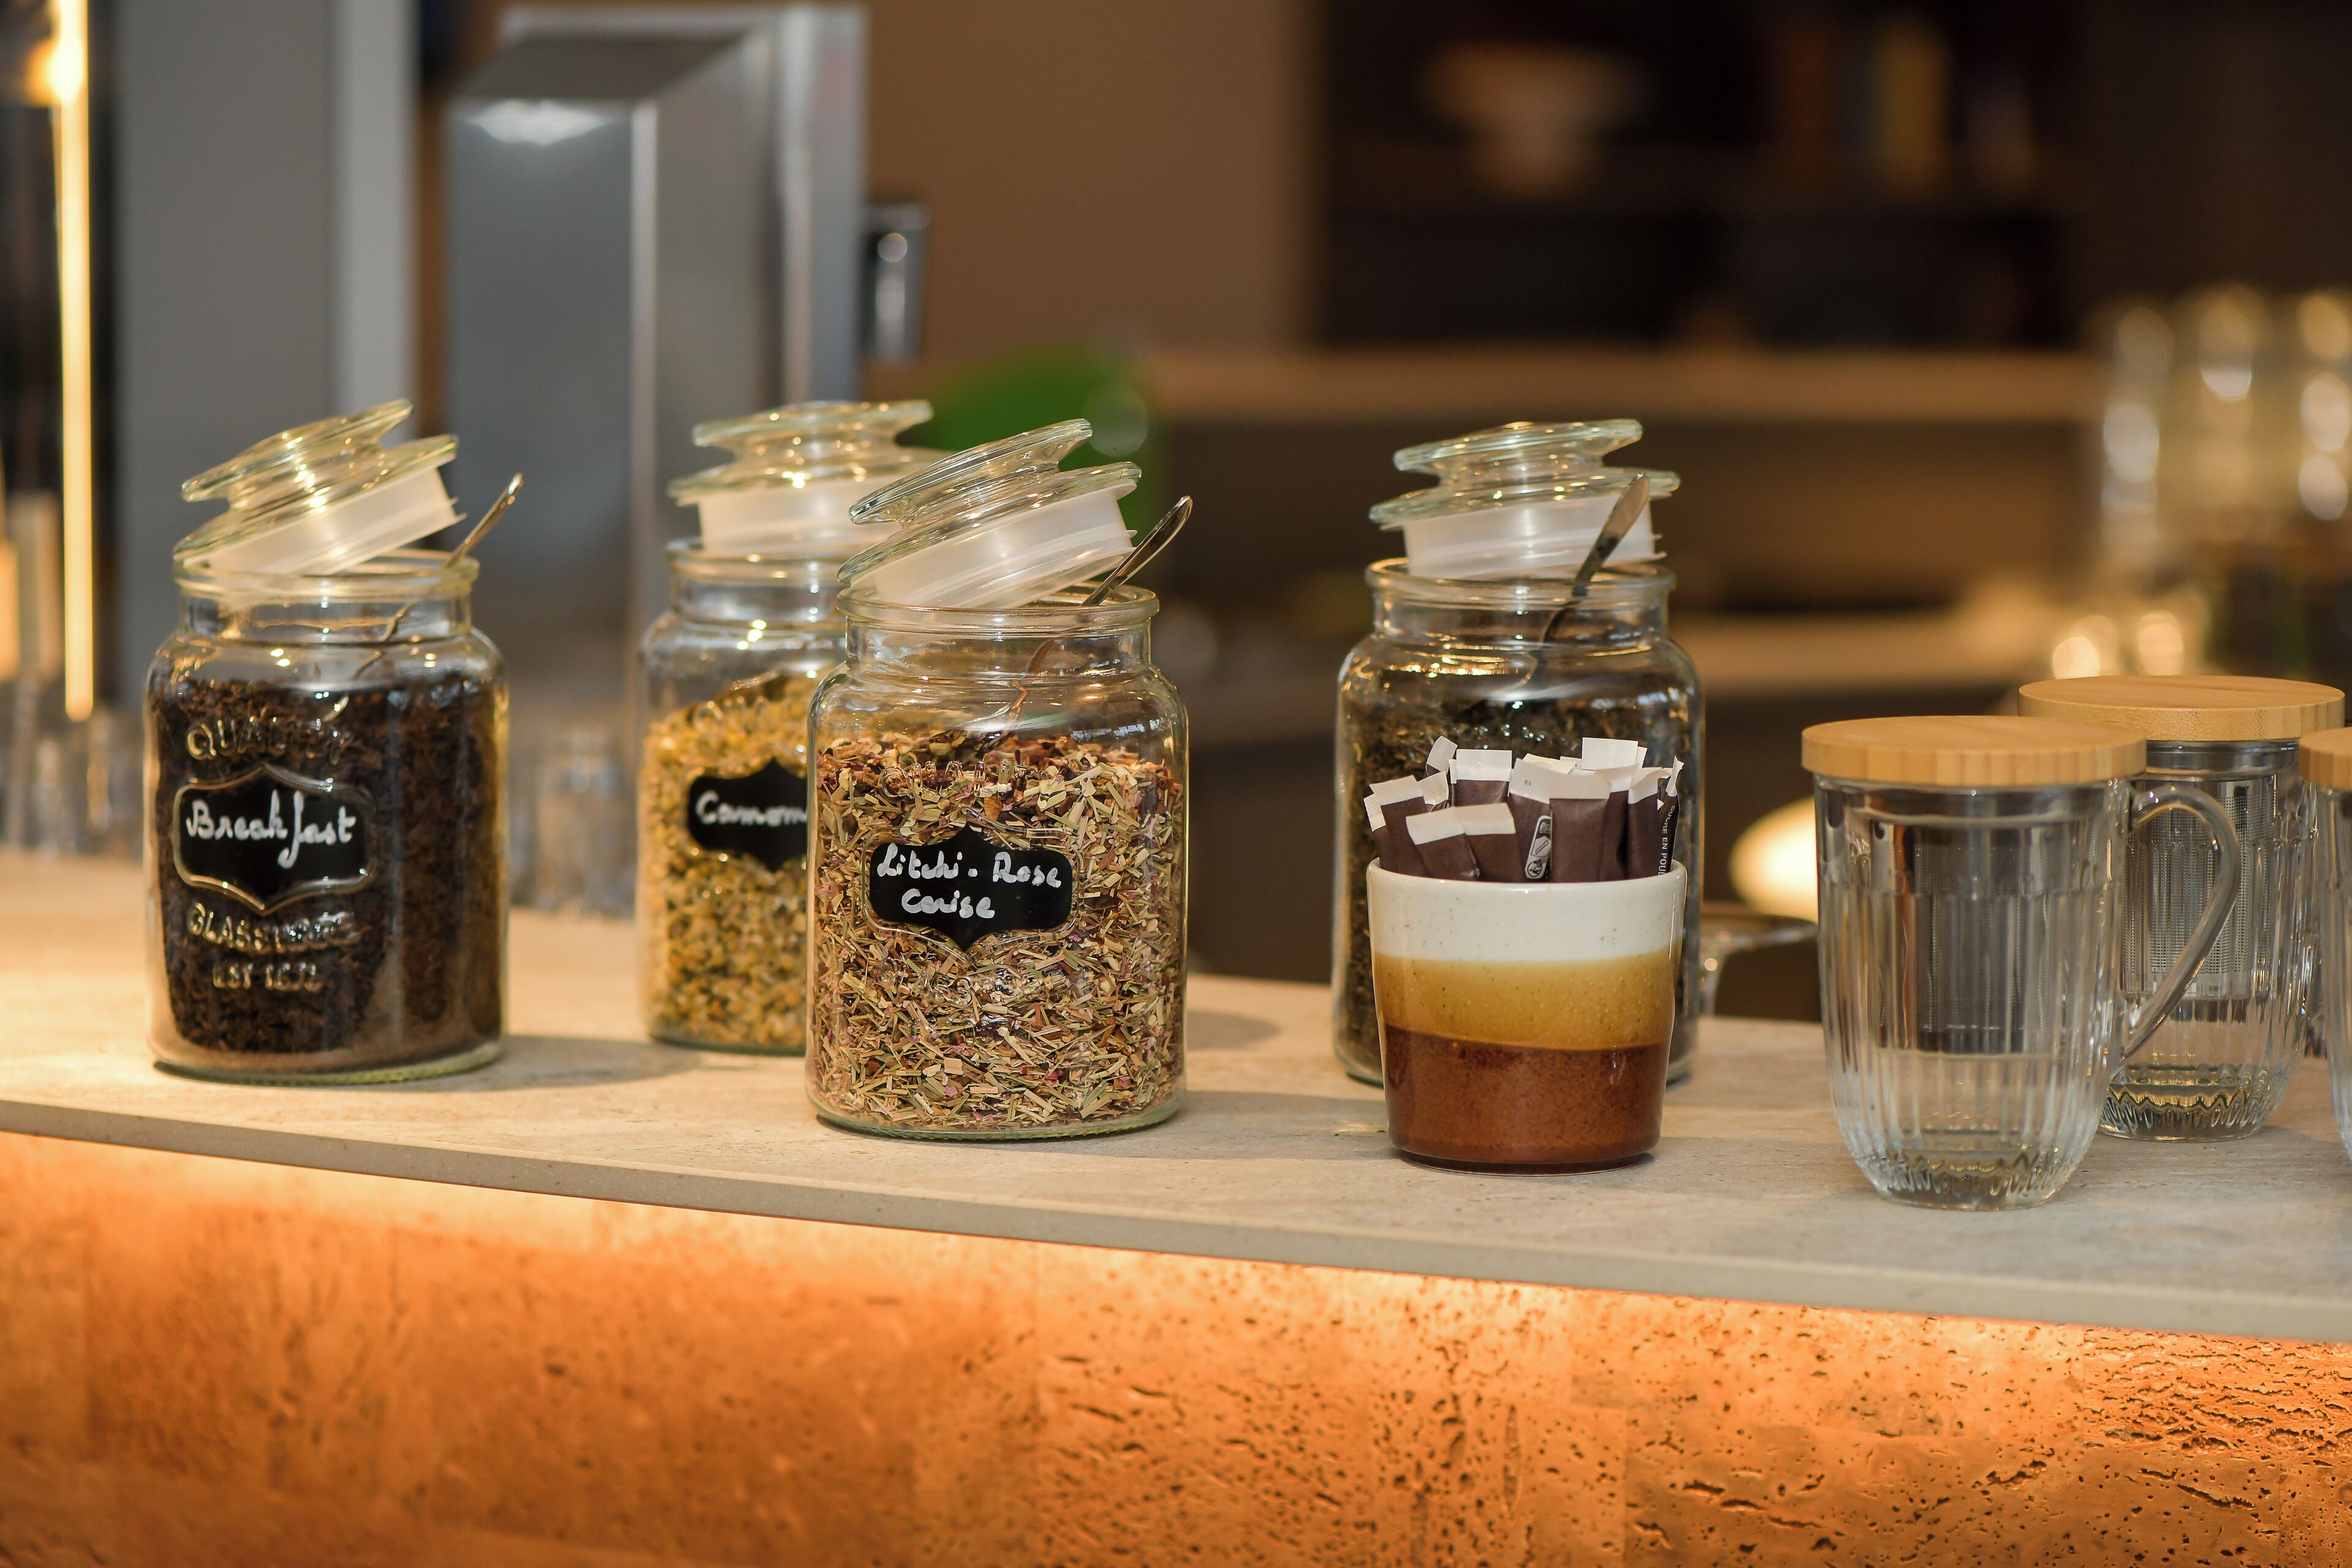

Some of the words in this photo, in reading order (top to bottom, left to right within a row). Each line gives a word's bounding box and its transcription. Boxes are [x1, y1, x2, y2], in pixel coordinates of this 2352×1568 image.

[186, 789, 356, 869] Breakfast
[1662, 805, 1676, 834] SUCRE
[1662, 837, 1668, 850] EN
[877, 843, 963, 879] Litchi
[992, 851, 1061, 888] Rose
